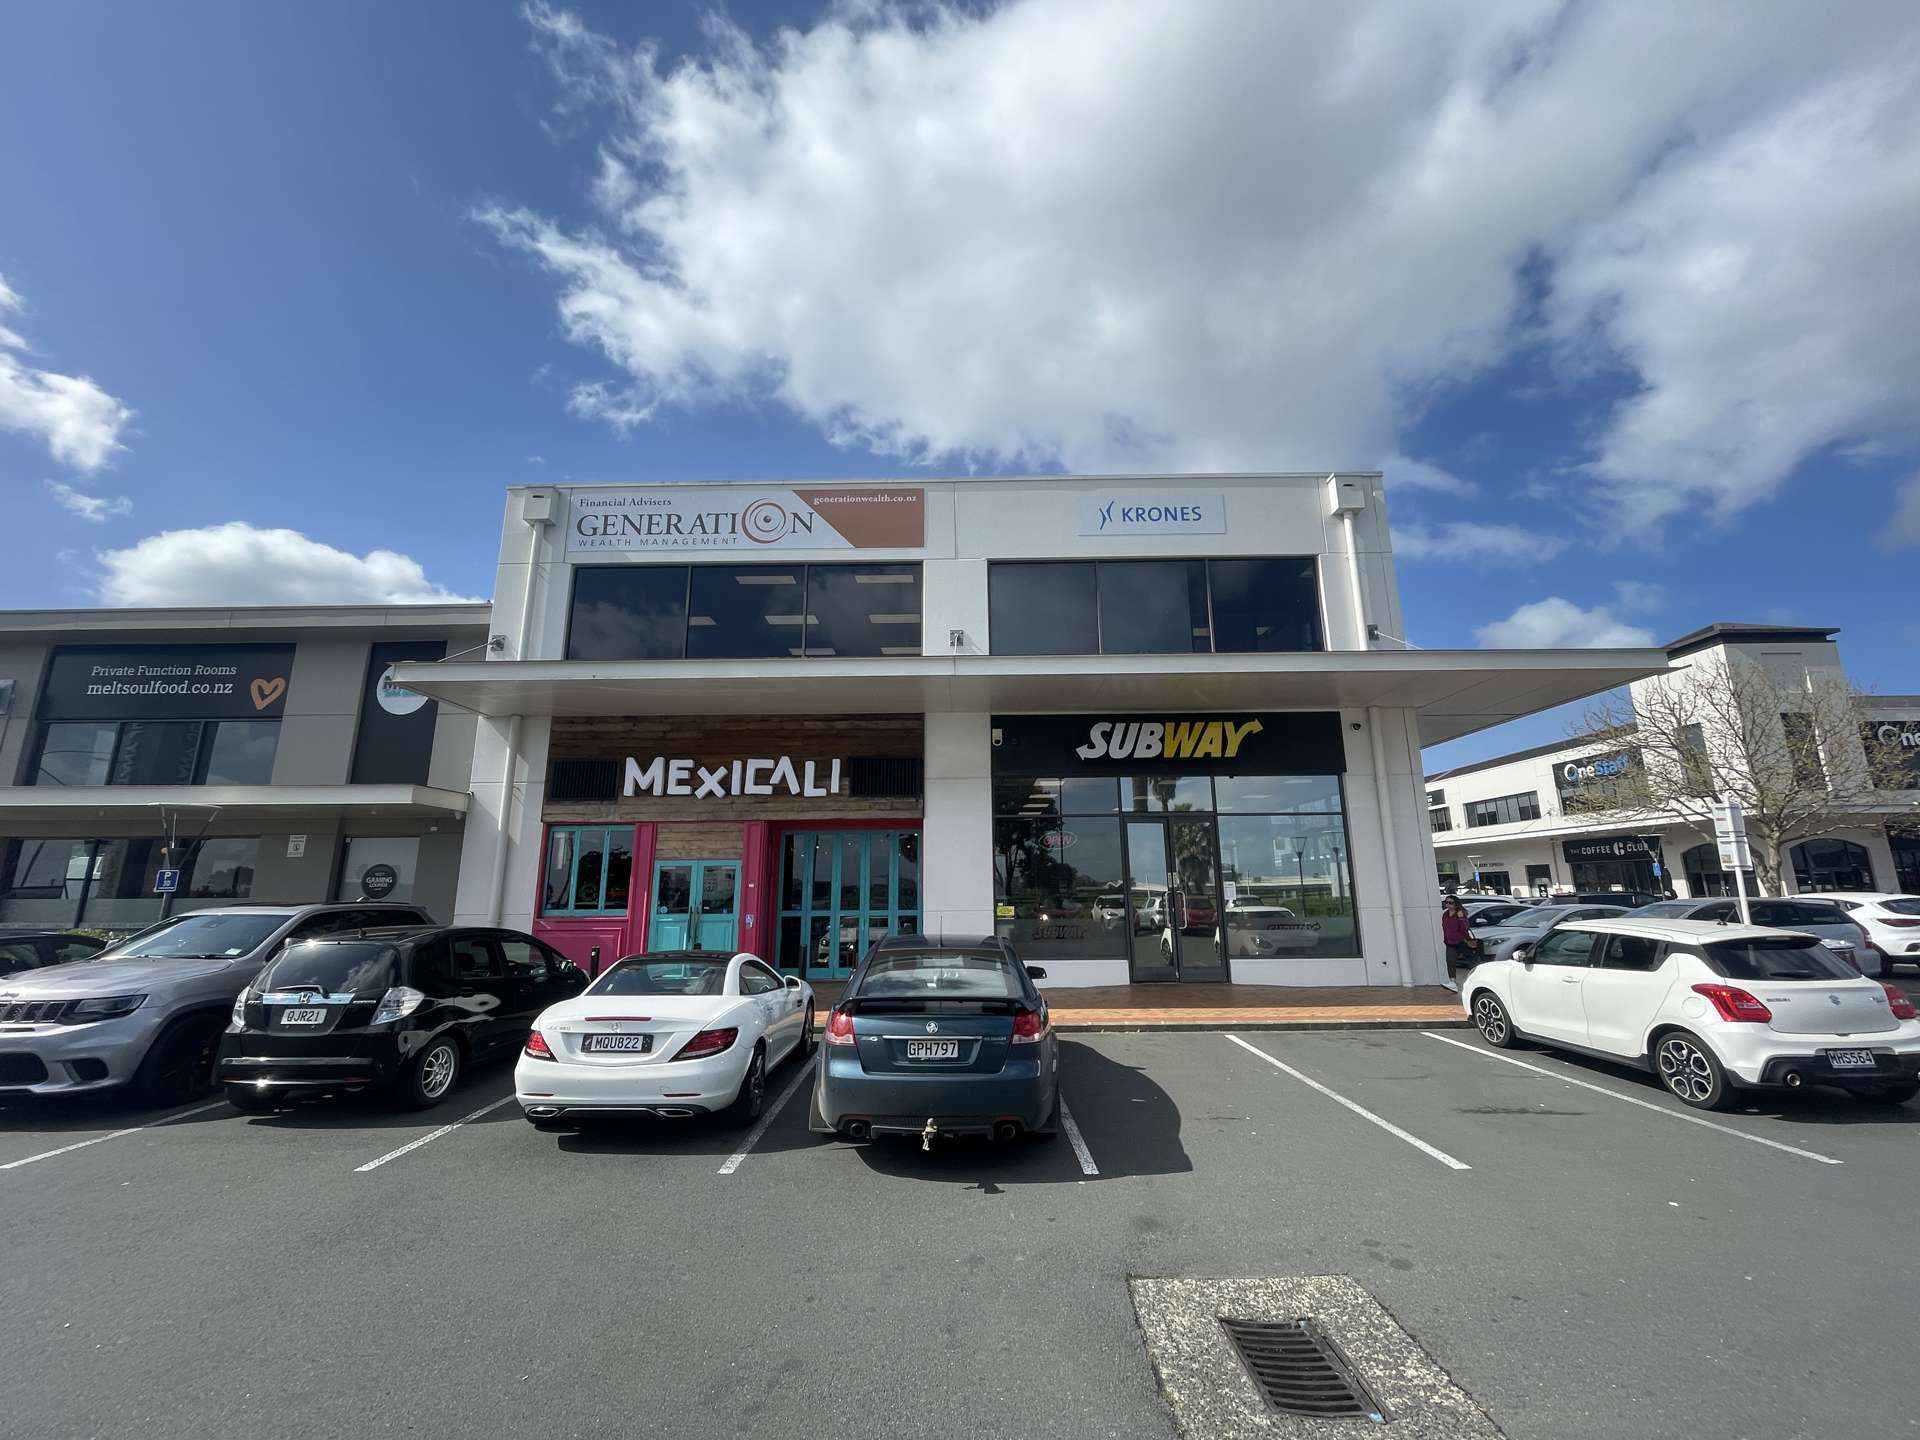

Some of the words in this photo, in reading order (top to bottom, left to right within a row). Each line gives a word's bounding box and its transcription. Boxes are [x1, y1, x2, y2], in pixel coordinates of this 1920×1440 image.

[579, 498, 626, 507] Financial
[629, 498, 672, 507] Advisers
[813, 494, 918, 505] generationwealth.co.nz
[1122, 506, 1202, 522] KRONES
[578, 538, 632, 547] WEALTH
[640, 537, 738, 546] MANAGEMENT
[91, 665, 135, 676] Private
[137, 664, 192, 676] Function
[194, 664, 238, 676] Rooms
[86, 680, 234, 696] meltsoulfood.co.nz
[1075, 718, 1264, 760] SUBWAY
[623, 756, 841, 800] MEXICALI
[1581, 845, 1611, 855] COFFEE
[164, 871, 171, 880] P
[595, 1037, 639, 1049] MQU822
[908, 1042, 957, 1056] GPH797
[1829, 1050, 1873, 1065] MHS564
